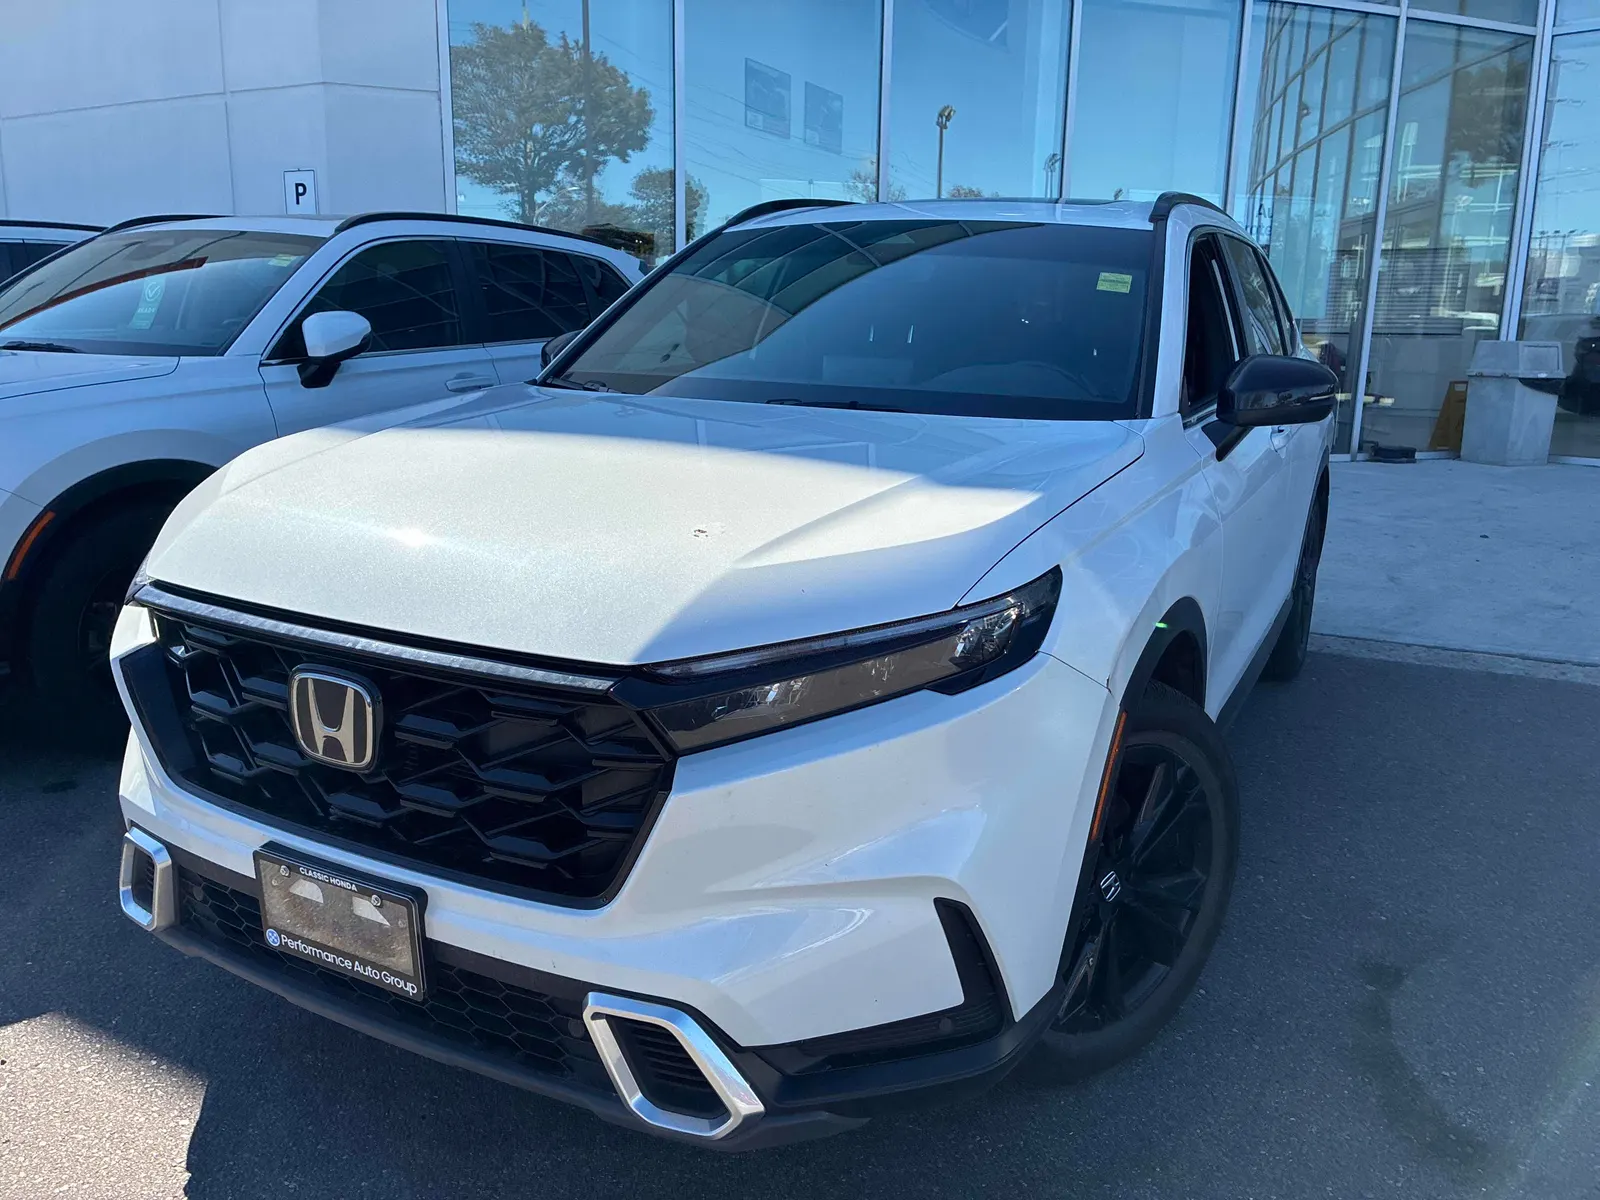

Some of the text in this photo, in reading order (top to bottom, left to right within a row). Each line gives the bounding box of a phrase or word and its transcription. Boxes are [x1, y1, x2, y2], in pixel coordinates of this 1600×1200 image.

[295, 182, 307, 205] P
[299, 867, 358, 892] CLASSIC HONDA
[280, 934, 418, 996] Performance Auto Group
